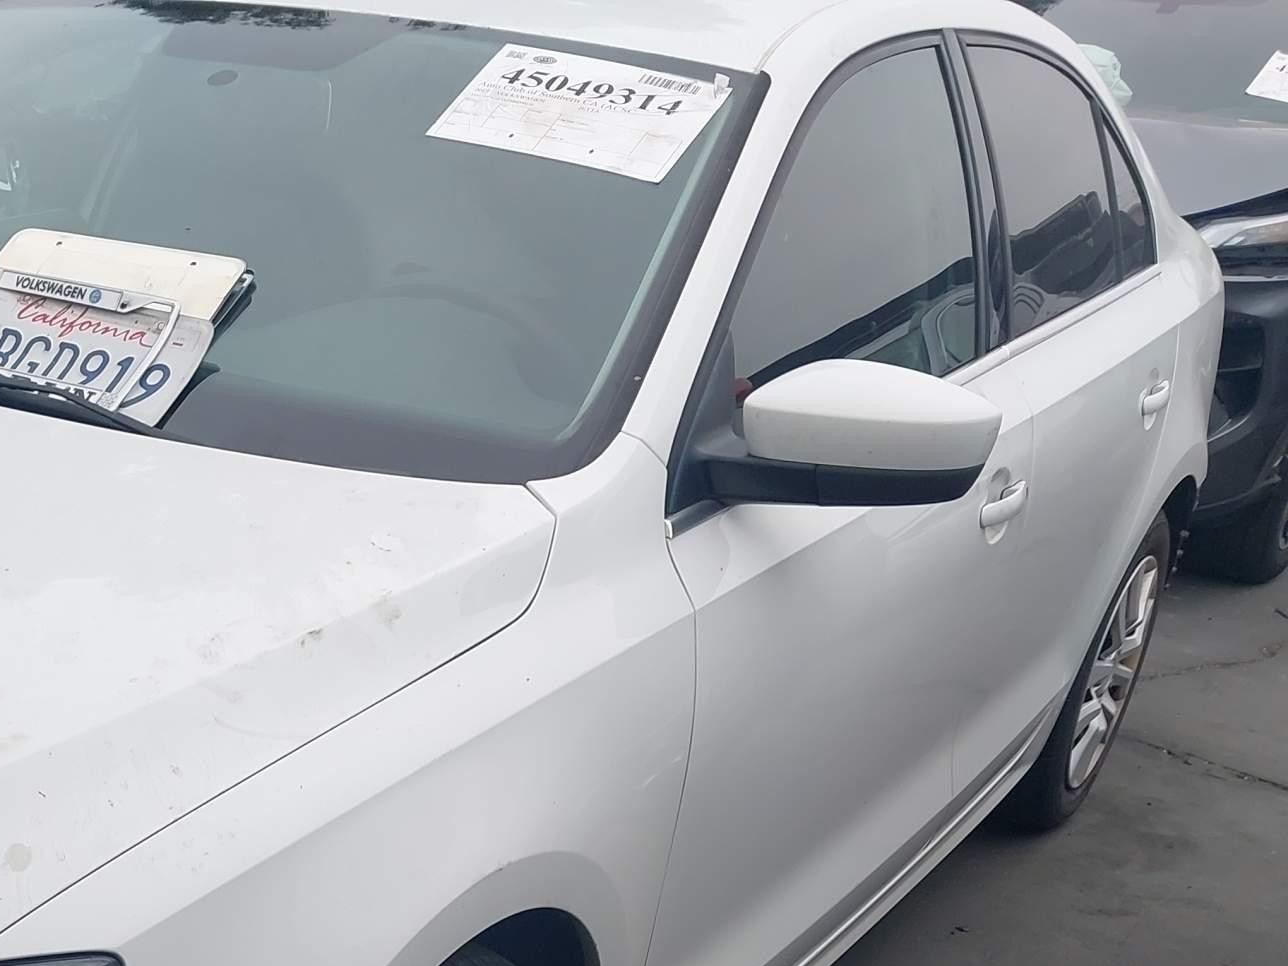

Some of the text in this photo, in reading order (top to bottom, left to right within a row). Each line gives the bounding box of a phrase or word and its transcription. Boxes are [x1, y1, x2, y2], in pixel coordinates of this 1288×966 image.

[501, 68, 683, 115] 45049314
[15, 275, 87, 300] VOLKSWAGEN
[16, 297, 154, 348] California
